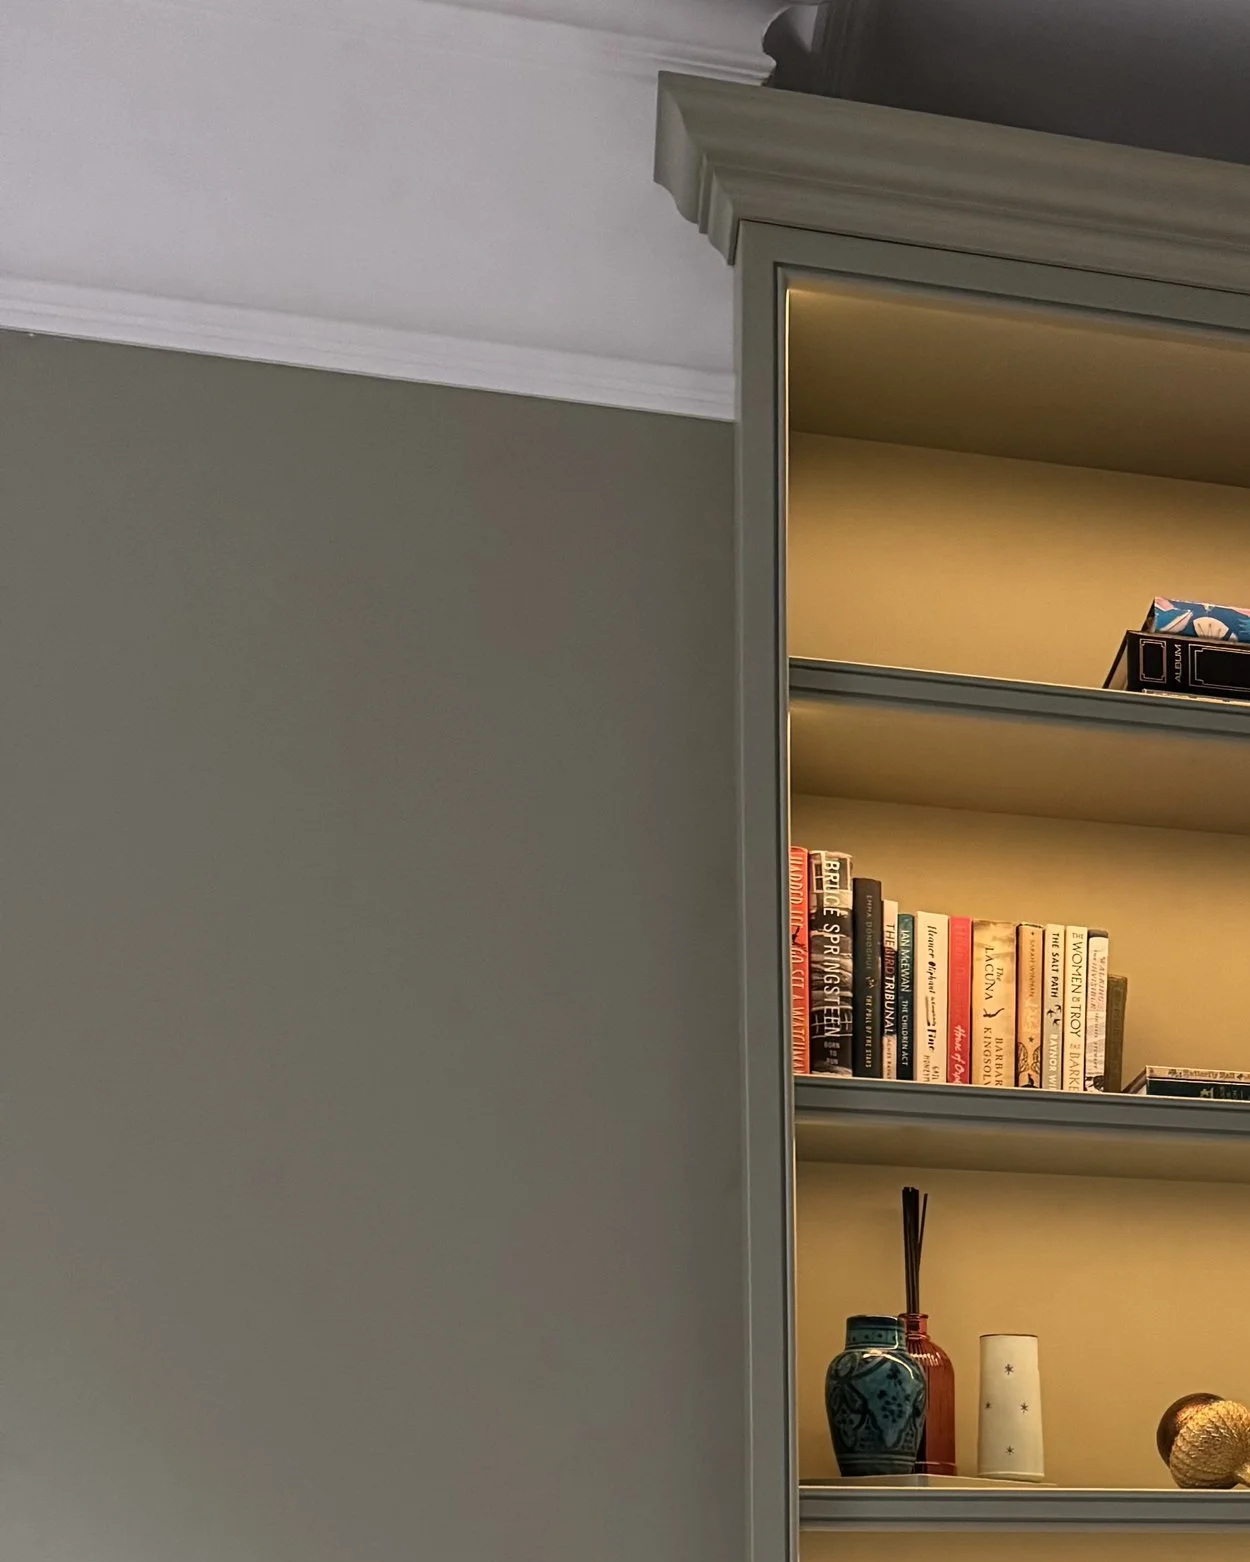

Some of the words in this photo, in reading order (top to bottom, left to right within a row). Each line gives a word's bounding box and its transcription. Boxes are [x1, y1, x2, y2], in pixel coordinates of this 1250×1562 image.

[1174, 643, 1183, 684] ALBUM
[823, 860, 840, 917] BRUCE
[885, 924, 895, 948] THE
[900, 930, 910, 947] IAN
[1050, 932, 1060, 949] THE
[1072, 932, 1084, 940] THE
[884, 947, 895, 974] BIRD
[900, 949, 912, 993] McEWAN
[984, 946, 996, 1001] LACUNA
[1050, 952, 1060, 977] SALT
[1071, 941, 1083, 994] WOMEN
[823, 923, 841, 1037] SPRINGSTEEN
[996, 967, 1004, 982] The
[1050, 977, 1060, 998] PATH
[884, 975, 896, 1034] TRIBUNAL
[901, 1000, 909, 1013] THE
[901, 1015, 909, 1050] CHILDREN
[1070, 1004, 1082, 1038] TROY
[952, 1025, 966, 1051] House
[901, 1051, 909, 1066] ACT
[1048, 1034, 1060, 1071] RAYNOR
